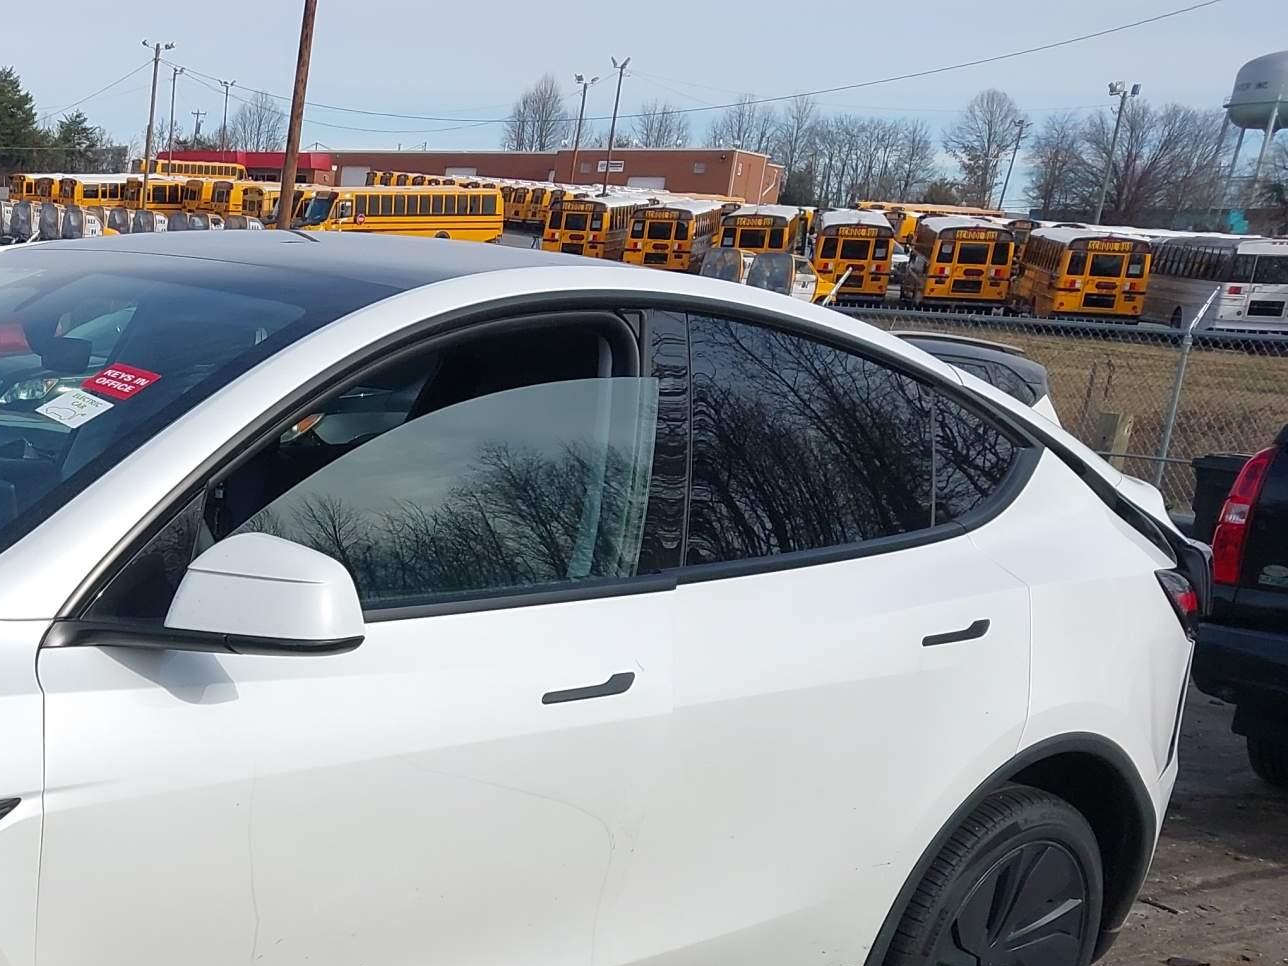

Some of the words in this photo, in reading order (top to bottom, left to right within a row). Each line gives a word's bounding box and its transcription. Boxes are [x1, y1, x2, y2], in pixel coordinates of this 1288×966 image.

[95, 377, 136, 393] OFFICE
[103, 369, 136, 381] KEYS
[134, 377, 150, 386] IN
